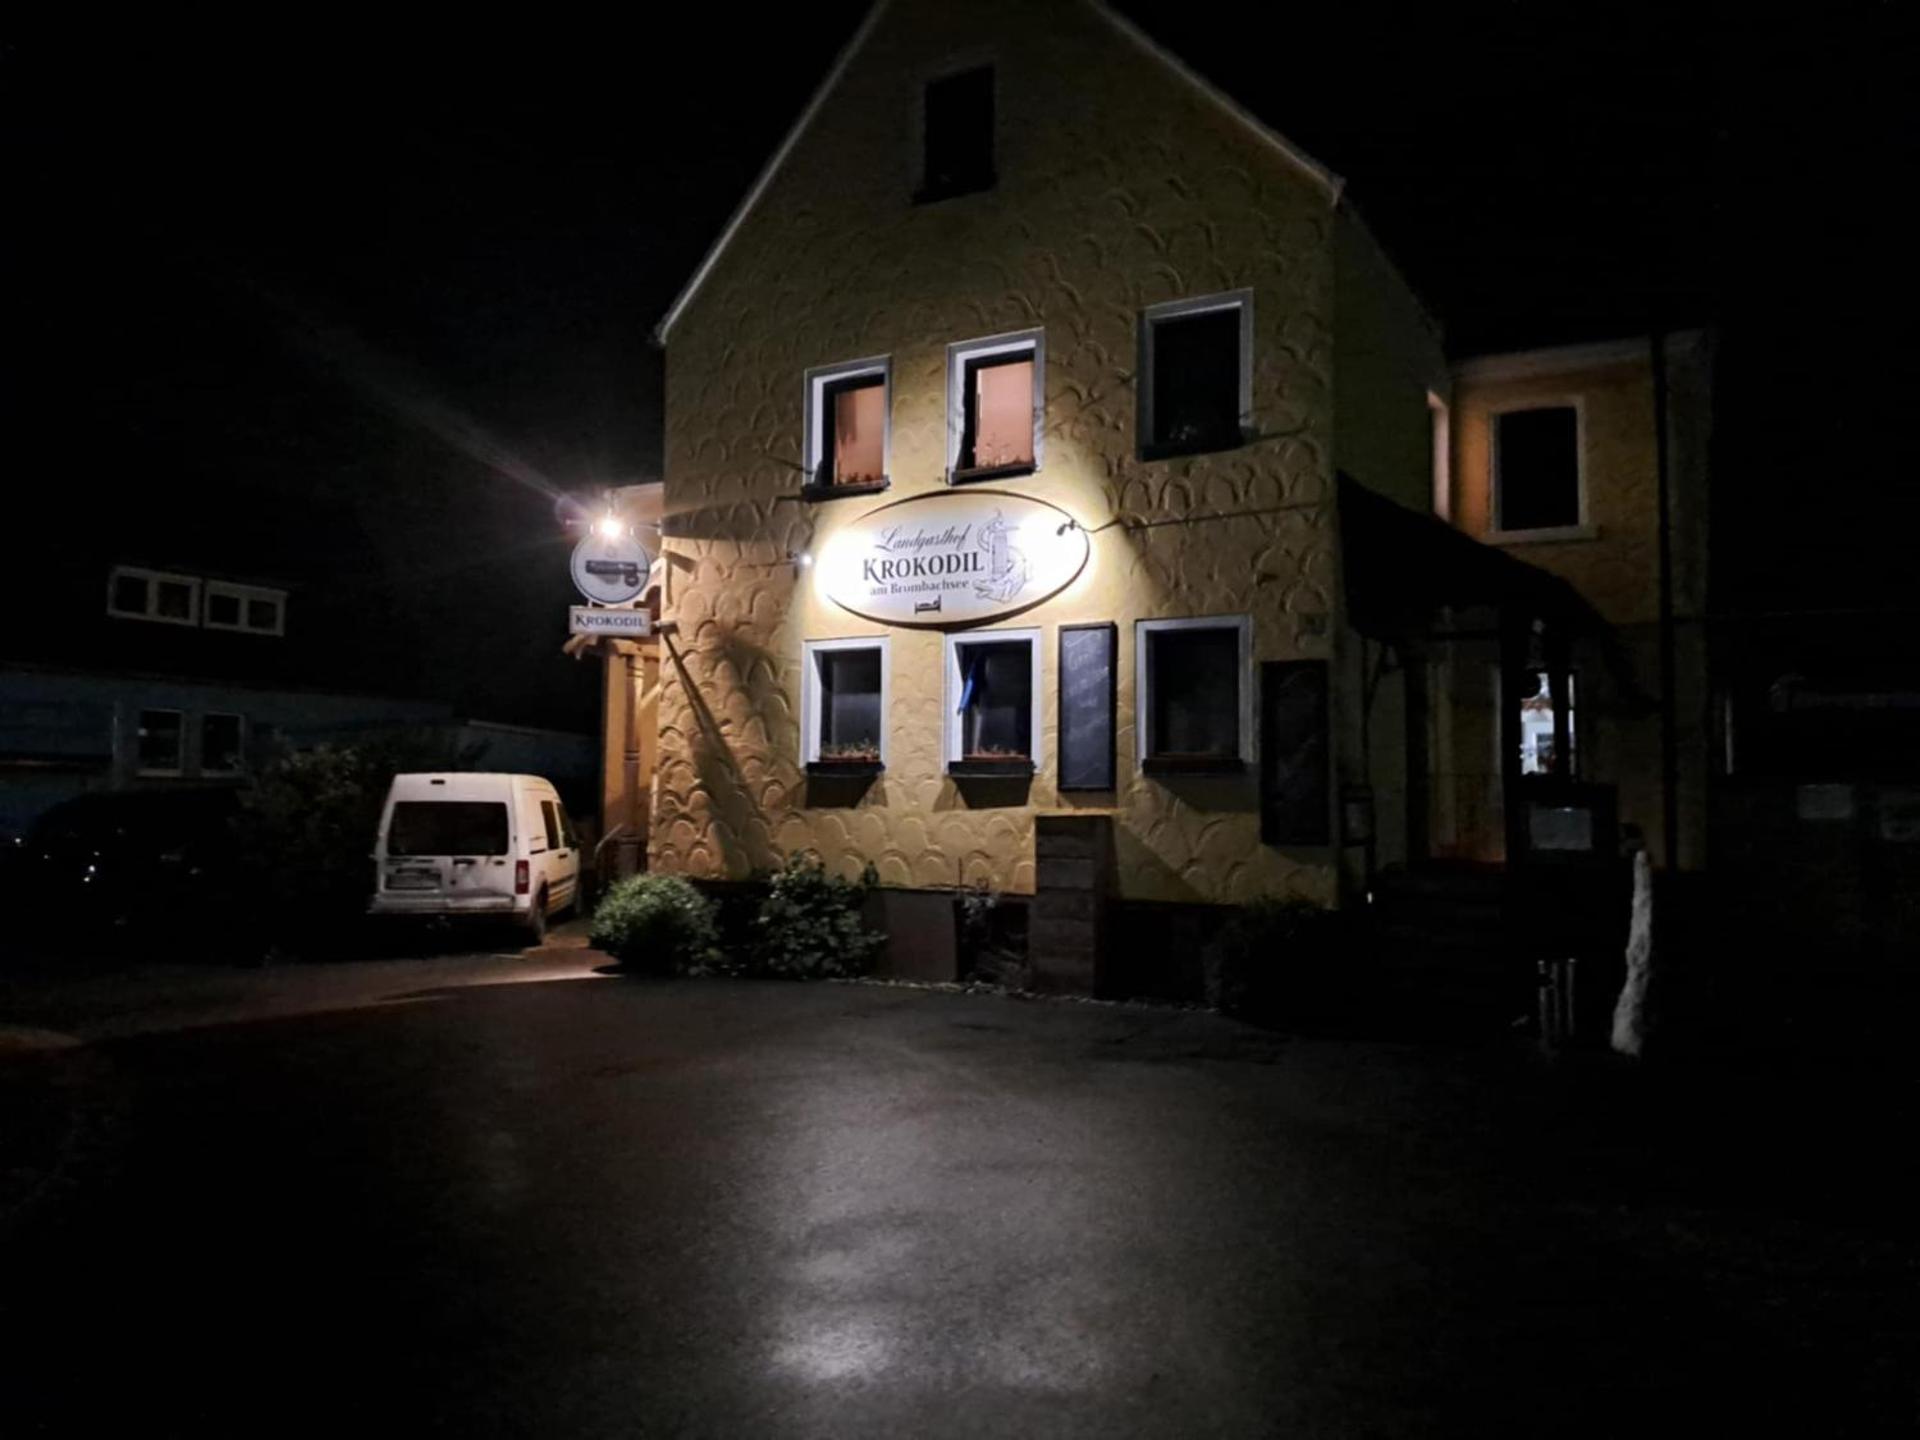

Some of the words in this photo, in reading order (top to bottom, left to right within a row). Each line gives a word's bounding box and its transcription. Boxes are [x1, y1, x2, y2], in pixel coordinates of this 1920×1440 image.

[875, 524, 972, 552] Landgasthof
[863, 552, 984, 584] KROKODIL
[871, 585, 887, 596] am
[890, 578, 970, 595] Brombachsee
[575, 614, 643, 628] KROKODIL
